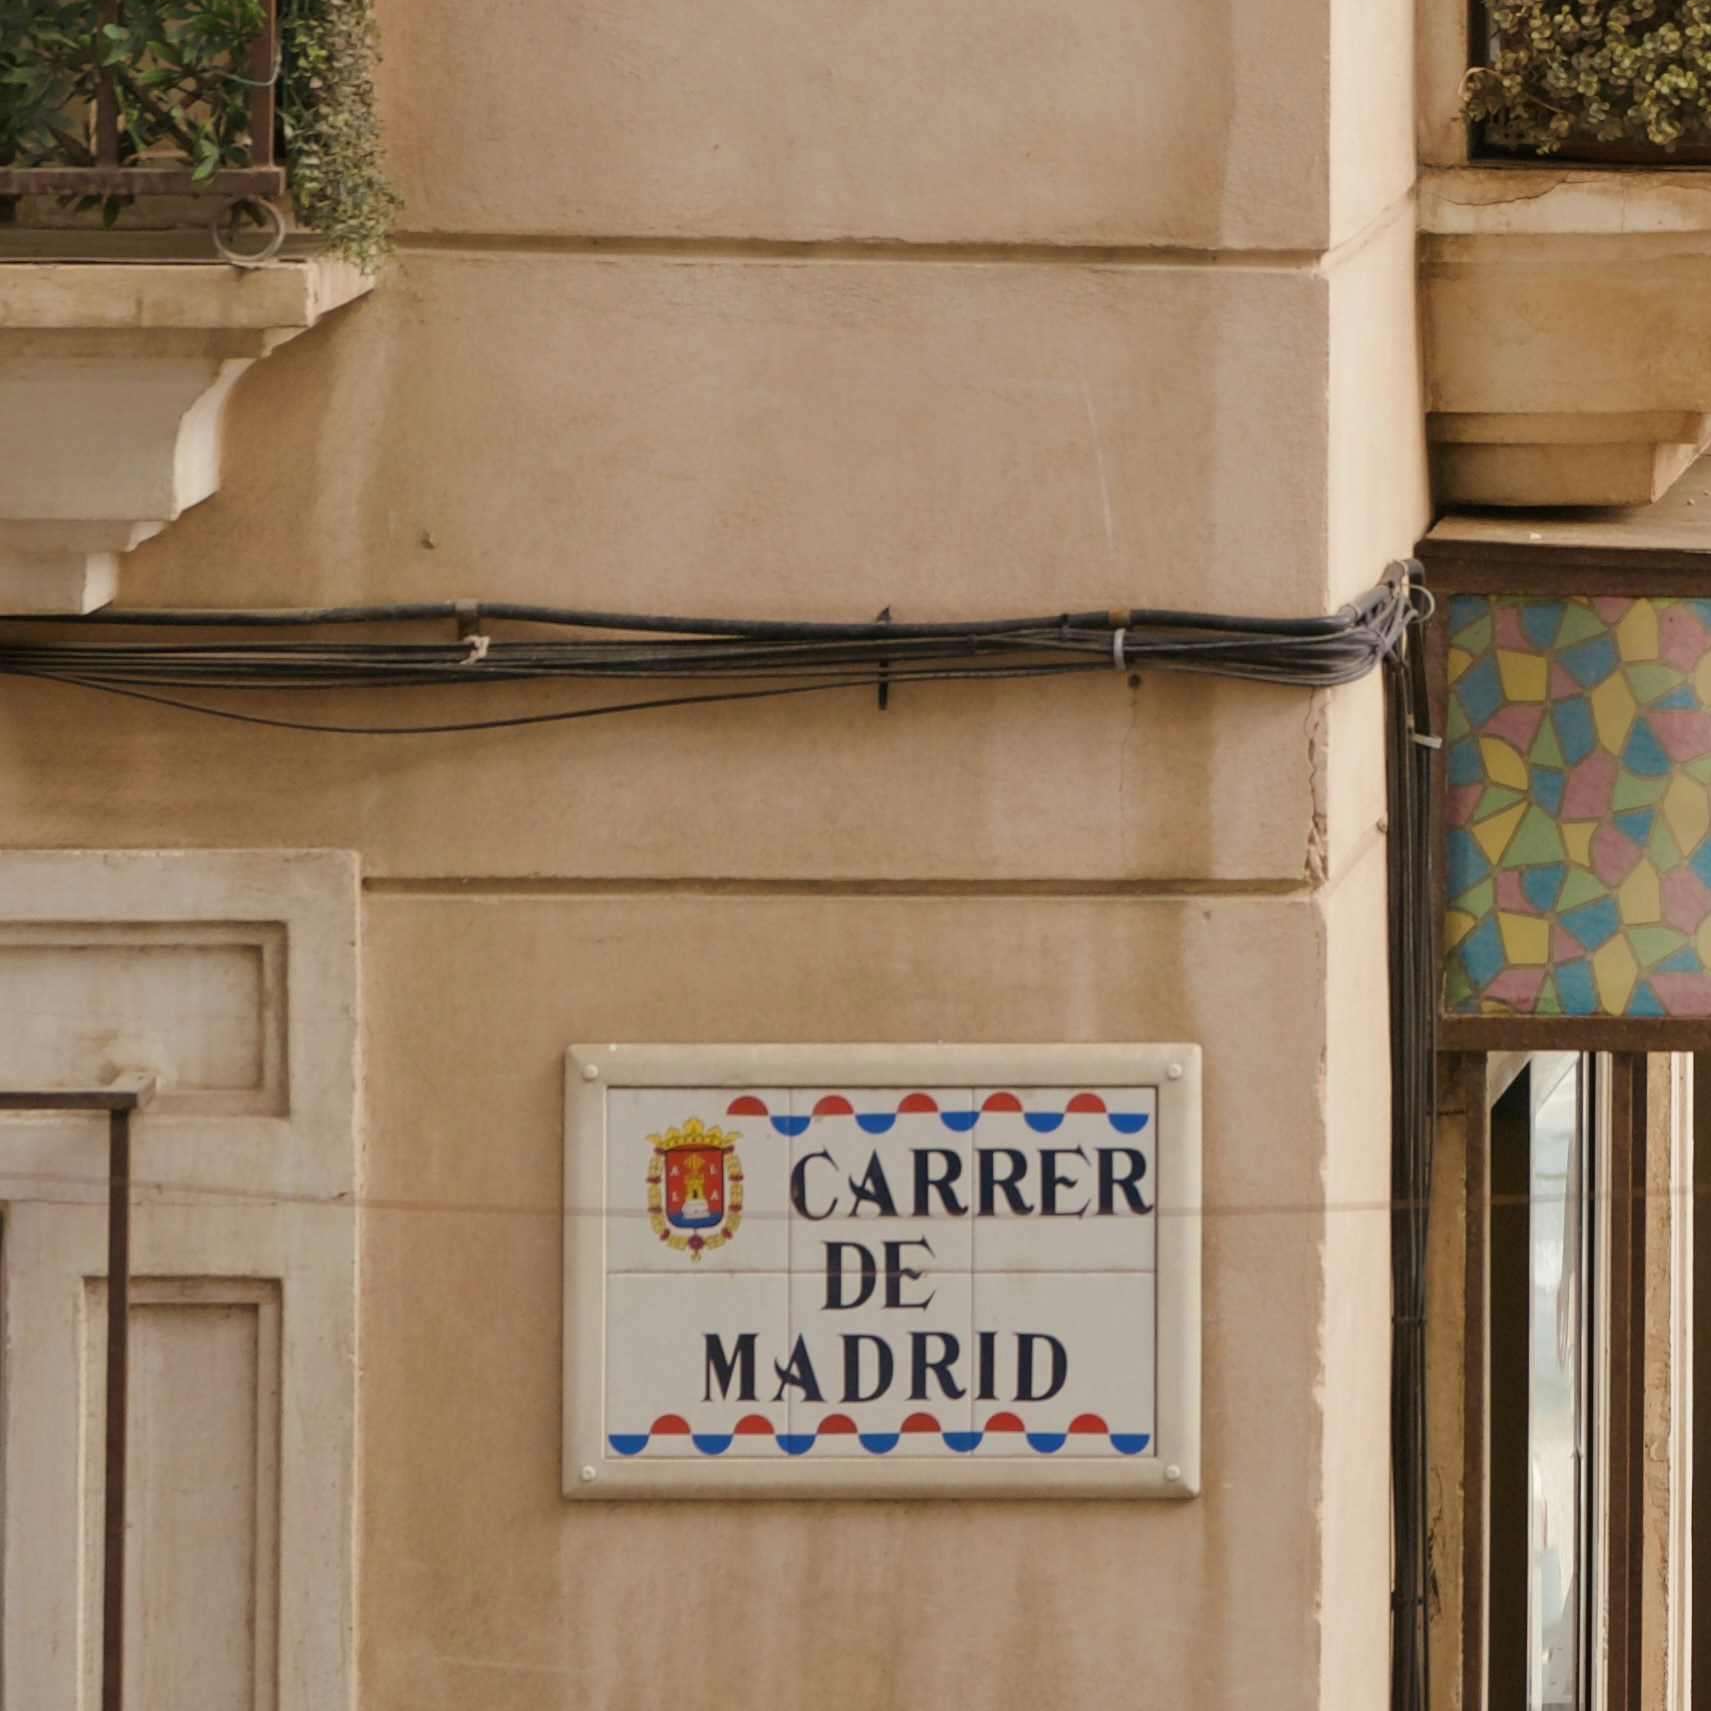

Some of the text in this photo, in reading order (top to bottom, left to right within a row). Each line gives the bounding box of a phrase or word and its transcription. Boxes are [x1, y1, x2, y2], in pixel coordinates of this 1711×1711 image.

[789, 1145, 1154, 1221] CARRER
[820, 1237, 937, 1311] DE
[700, 1331, 1069, 1404] MADRID
